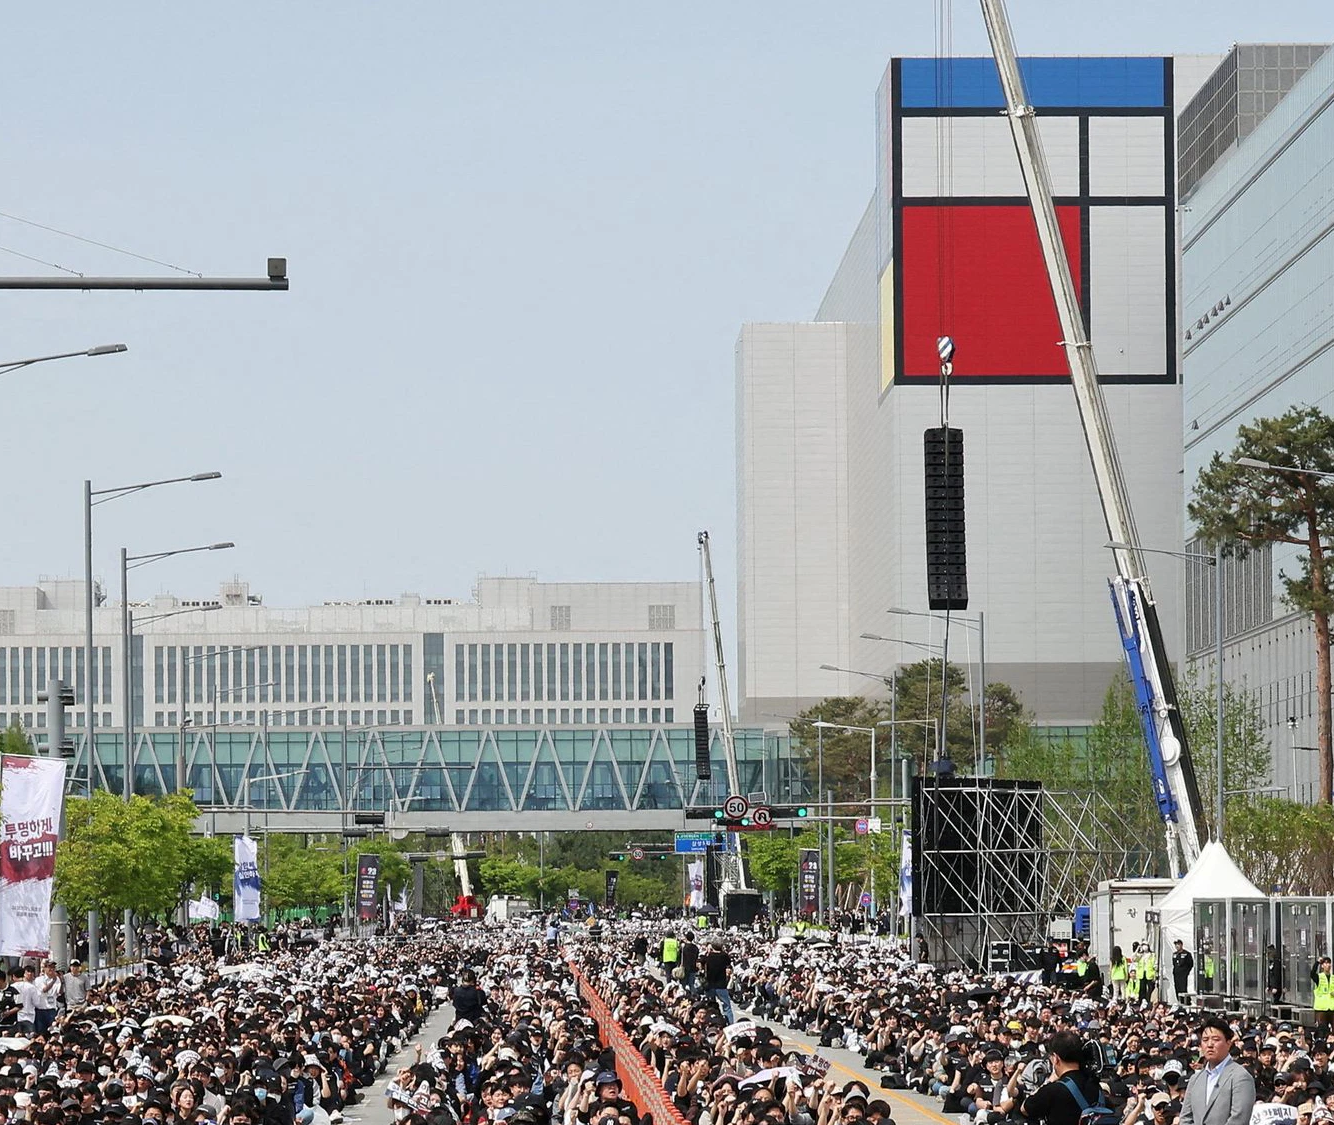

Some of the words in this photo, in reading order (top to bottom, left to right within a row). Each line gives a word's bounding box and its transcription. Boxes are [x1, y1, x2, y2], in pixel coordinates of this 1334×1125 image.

[729, 802, 744, 813] 50
[5, 818, 53, 839] 투명하게
[9, 841, 53, 861] 바꾸고!!!
[633, 850, 643, 859] 50
[1250, 1107, 1293, 1125] 상한폐지
